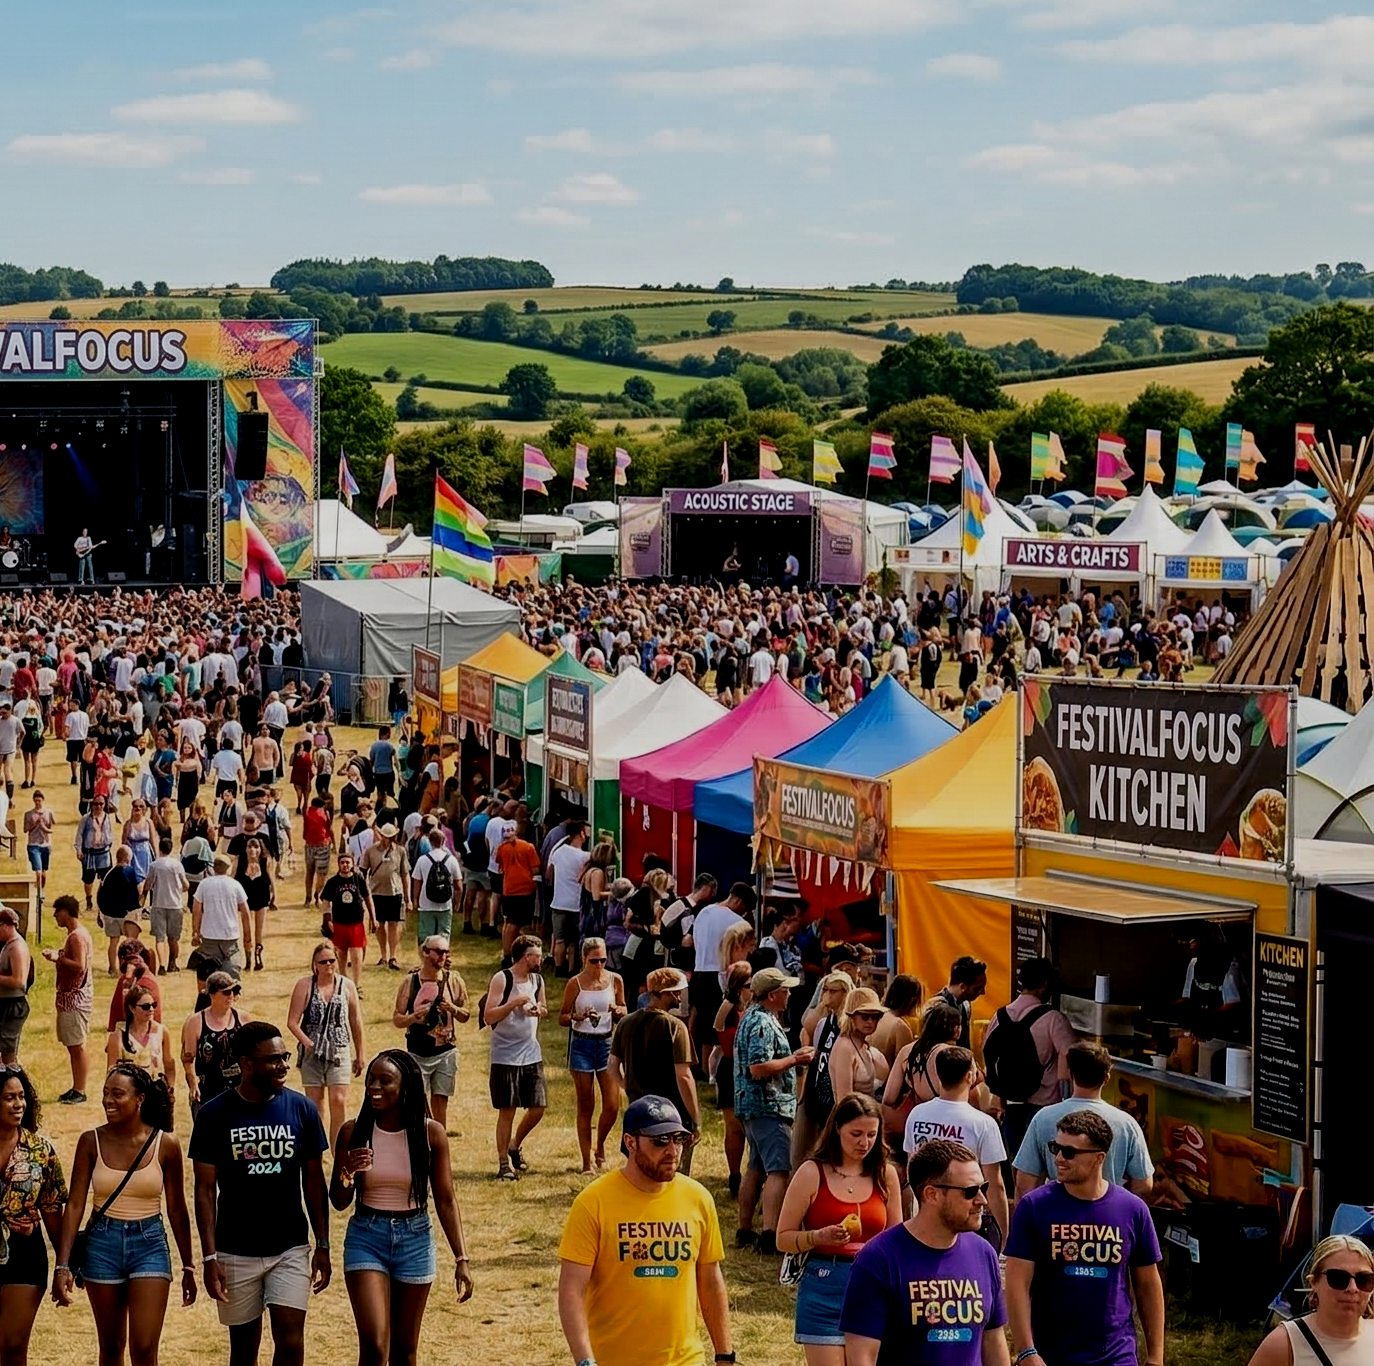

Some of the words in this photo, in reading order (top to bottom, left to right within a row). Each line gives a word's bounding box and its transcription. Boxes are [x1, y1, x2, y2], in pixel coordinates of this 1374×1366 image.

[684, 493, 748, 511] ACOUSTIC
[751, 494, 794, 511] STAGE
[1016, 543, 1055, 565] ARTS
[1057, 545, 1069, 566] &
[1071, 545, 1130, 568] CRAFTS
[1056, 703, 1242, 765] FESTIVALFOCUS
[781, 783, 855, 829] FESTIVALFOCUS
[1089, 764, 1206, 833] KITCHEN
[1259, 940, 1304, 969] KITCHEN
[230, 1124, 296, 1143] FESTIVAL
[913, 1121, 965, 1140] FESTIVAL
[231, 1141, 295, 1160] FOCUS
[247, 1161, 282, 1175] 2024
[617, 1221, 692, 1239] FESTIVAL
[1050, 1223, 1124, 1243] FESTIVAL
[1051, 1241, 1123, 1264] FOCUS
[908, 1278, 983, 1300] FESTIVAL
[911, 1299, 984, 1326] FOCUS
